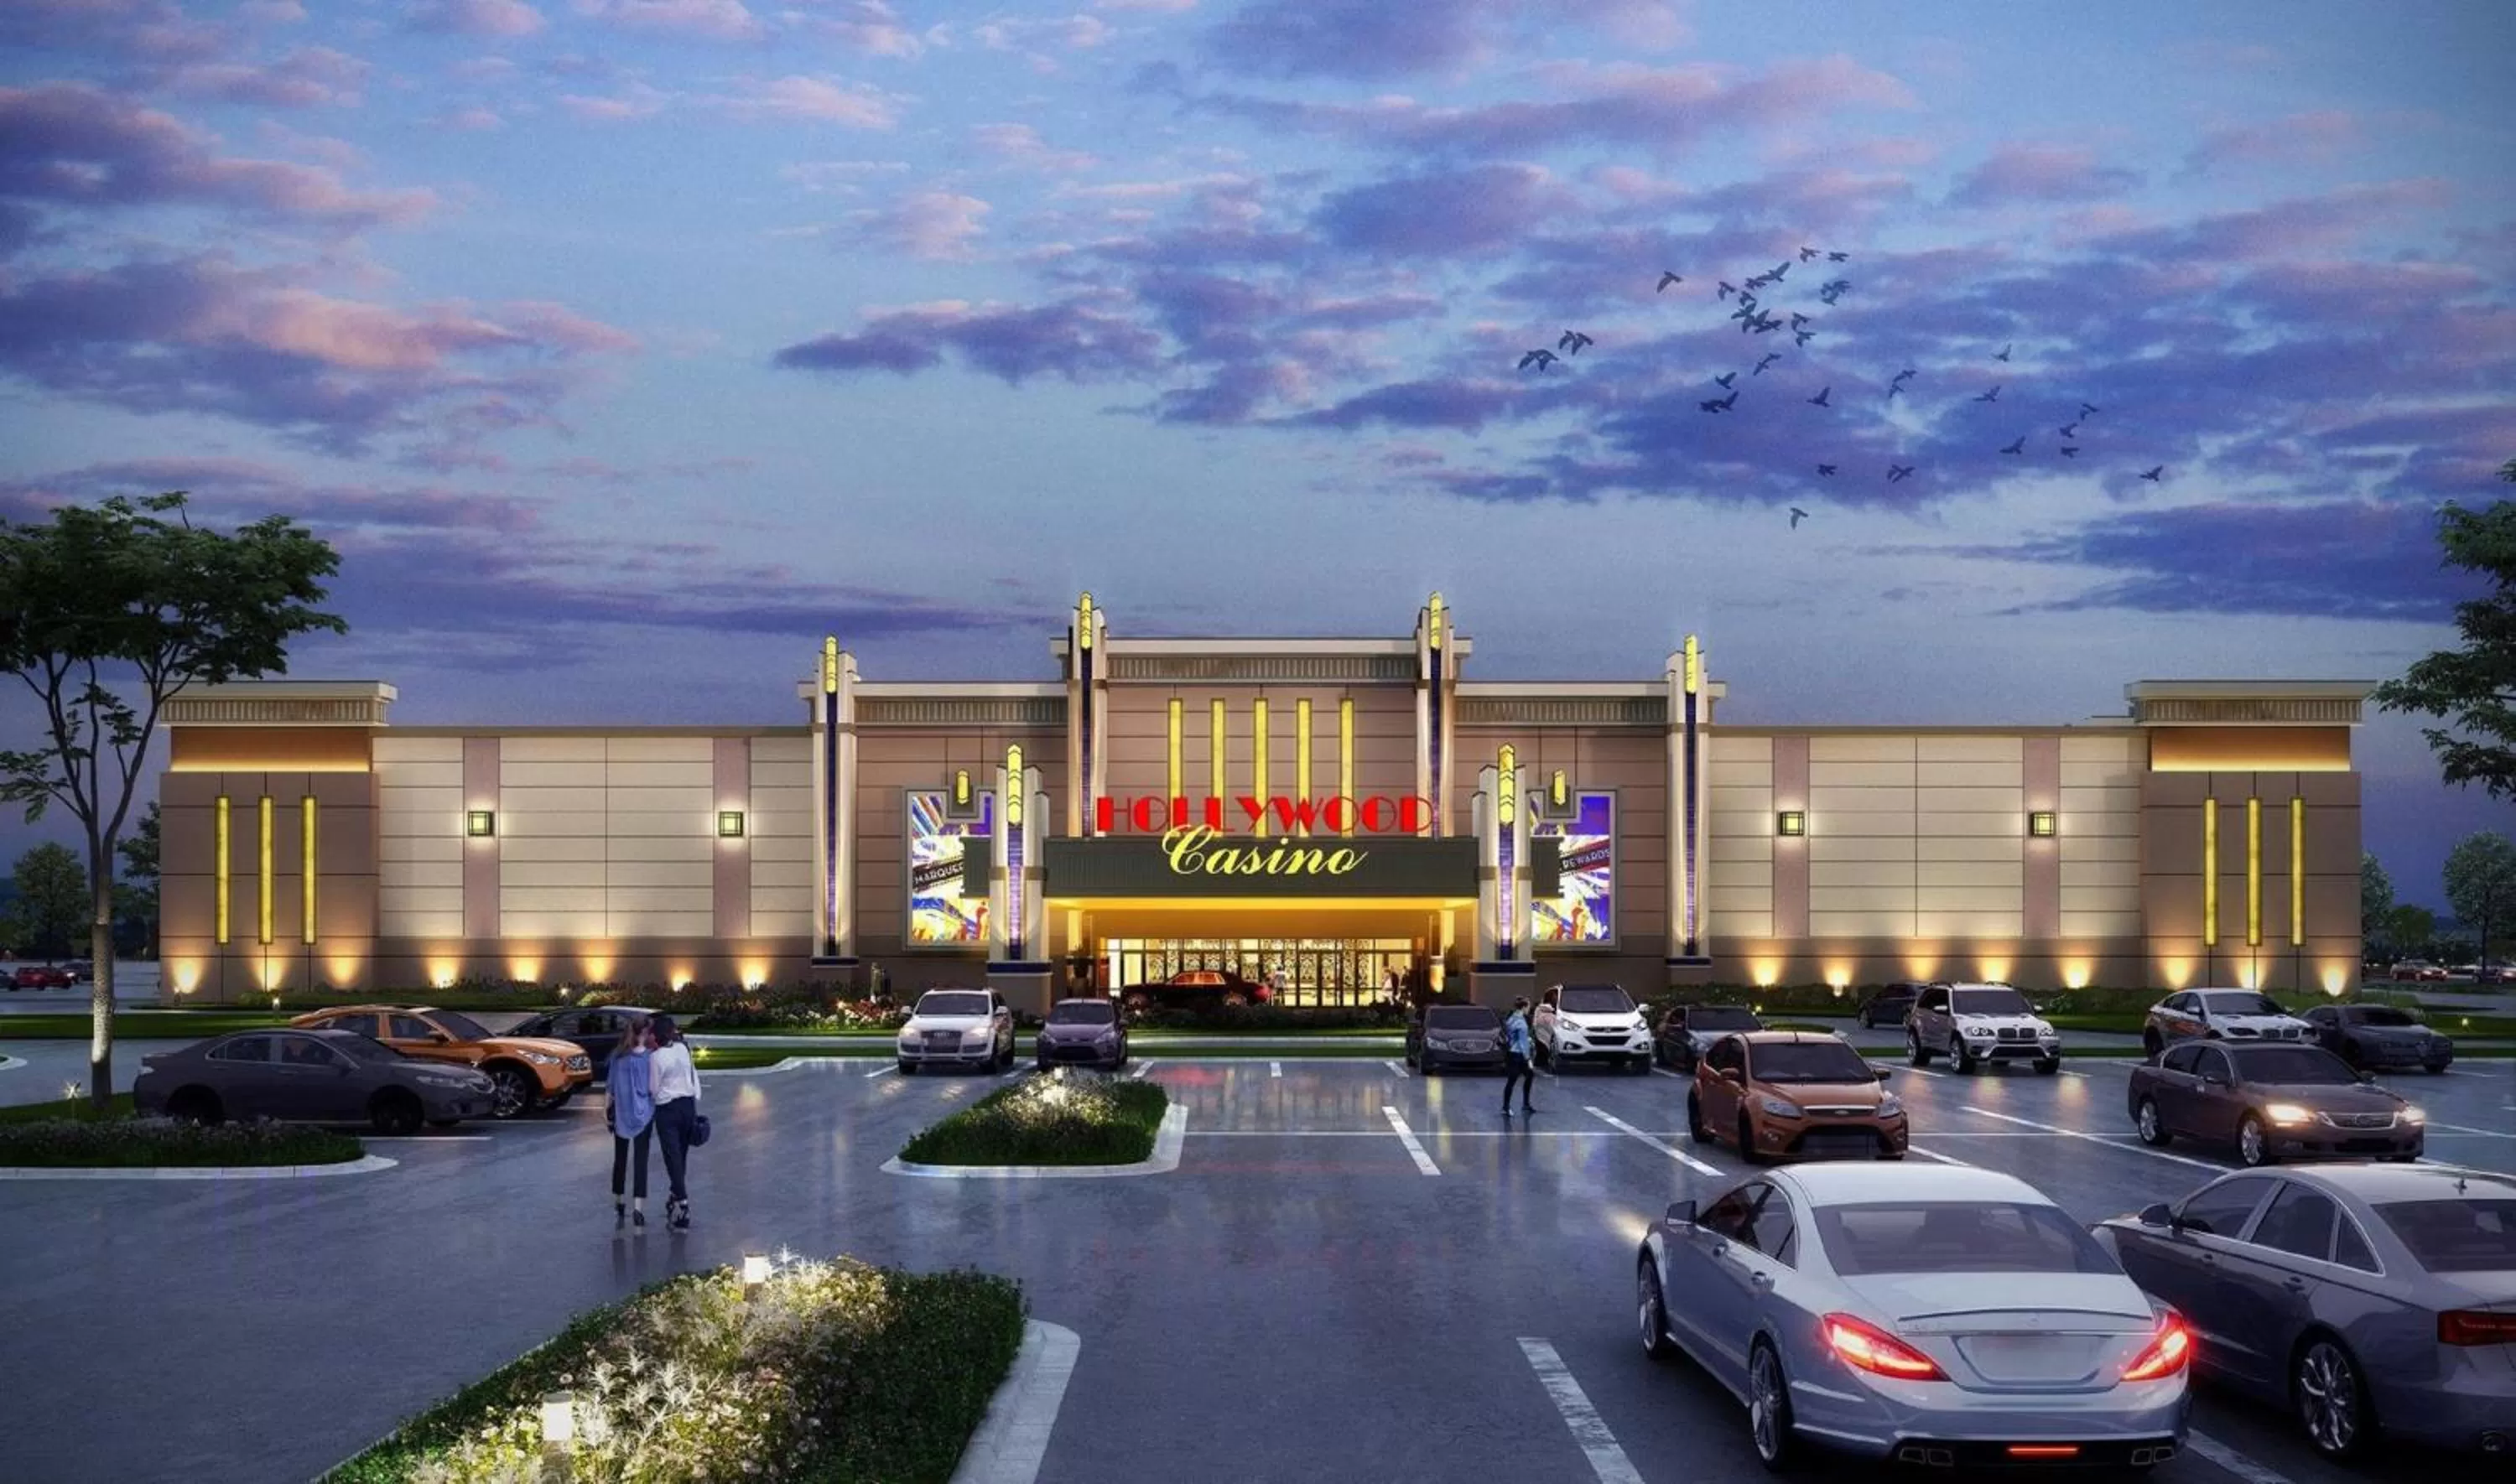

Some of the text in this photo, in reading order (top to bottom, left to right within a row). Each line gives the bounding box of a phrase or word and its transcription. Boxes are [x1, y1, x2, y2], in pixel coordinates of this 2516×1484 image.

[1097, 796, 1434, 833] HOLLYWOOD
[1162, 824, 1369, 874] Casino
[1562, 848, 1610, 869] REWARDS
